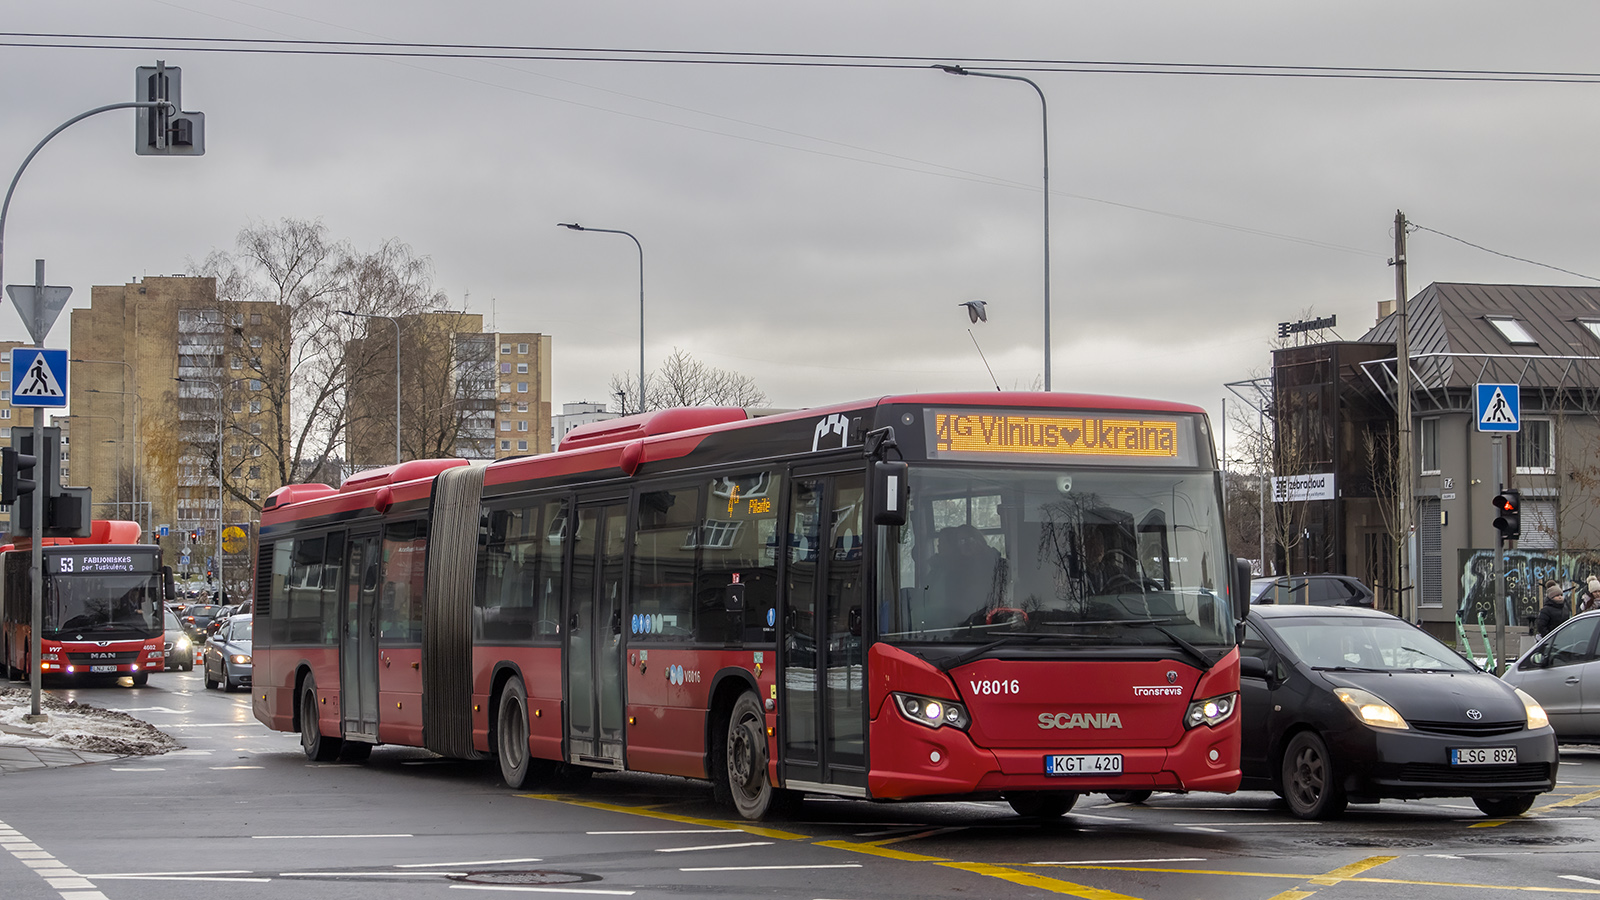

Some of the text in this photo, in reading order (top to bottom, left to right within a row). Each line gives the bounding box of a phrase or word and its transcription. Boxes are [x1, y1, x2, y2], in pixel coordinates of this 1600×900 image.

[980, 416, 1059, 448] Vilnius
[60, 557, 74, 573] 53
[684, 670, 701, 683] V8016
[970, 680, 1020, 695] V8016
[1132, 685, 1183, 696] Transrevis
[1037, 712, 1123, 730] SCANIA
[1055, 756, 1120, 771] KGT 420
[1459, 749, 1515, 763] LSG 892
